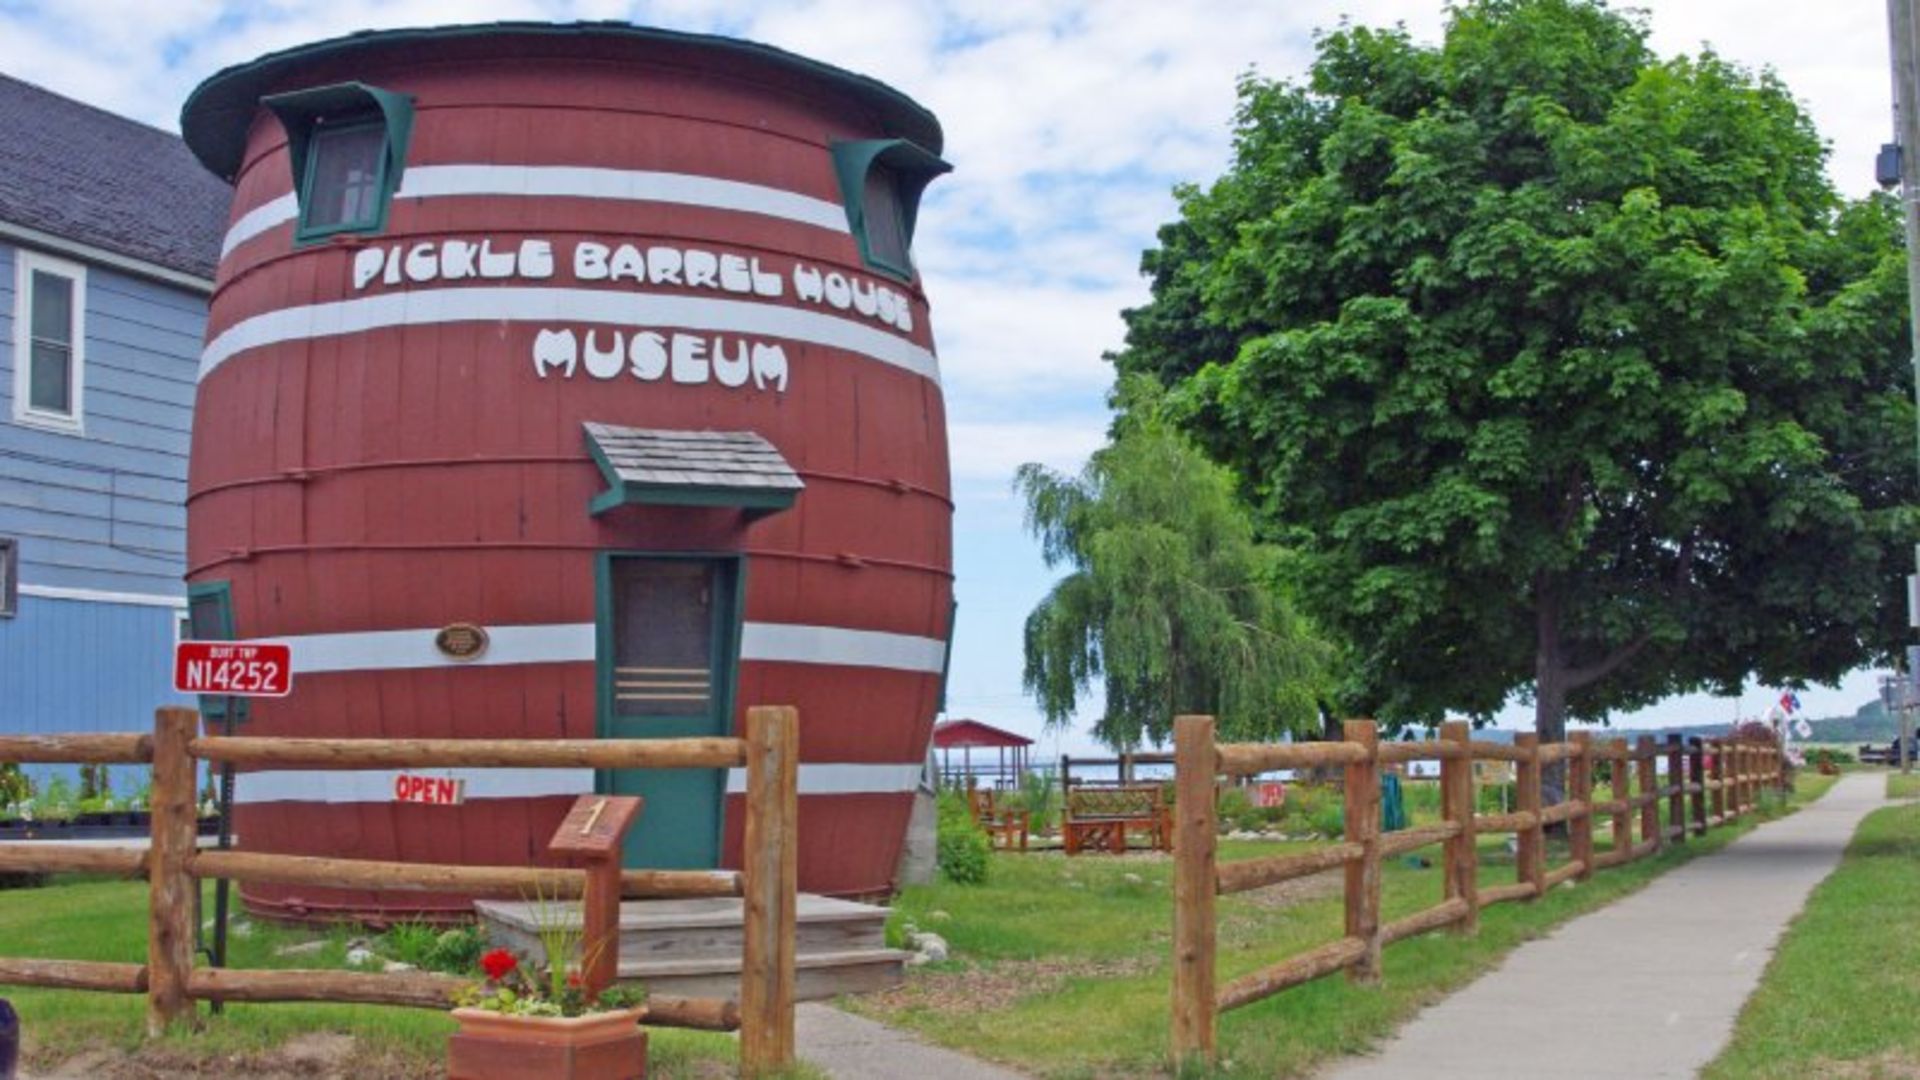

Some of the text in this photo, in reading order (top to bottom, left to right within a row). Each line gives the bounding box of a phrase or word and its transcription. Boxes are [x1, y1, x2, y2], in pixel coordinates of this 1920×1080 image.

[353, 239, 913, 333] PICKLE BARREL HOUSE
[532, 328, 789, 393] MUSEUM
[239, 648, 259, 658] TWP
[186, 659, 279, 691] N14252
[395, 774, 455, 804] OPEN
[578, 796, 608, 835] 1
